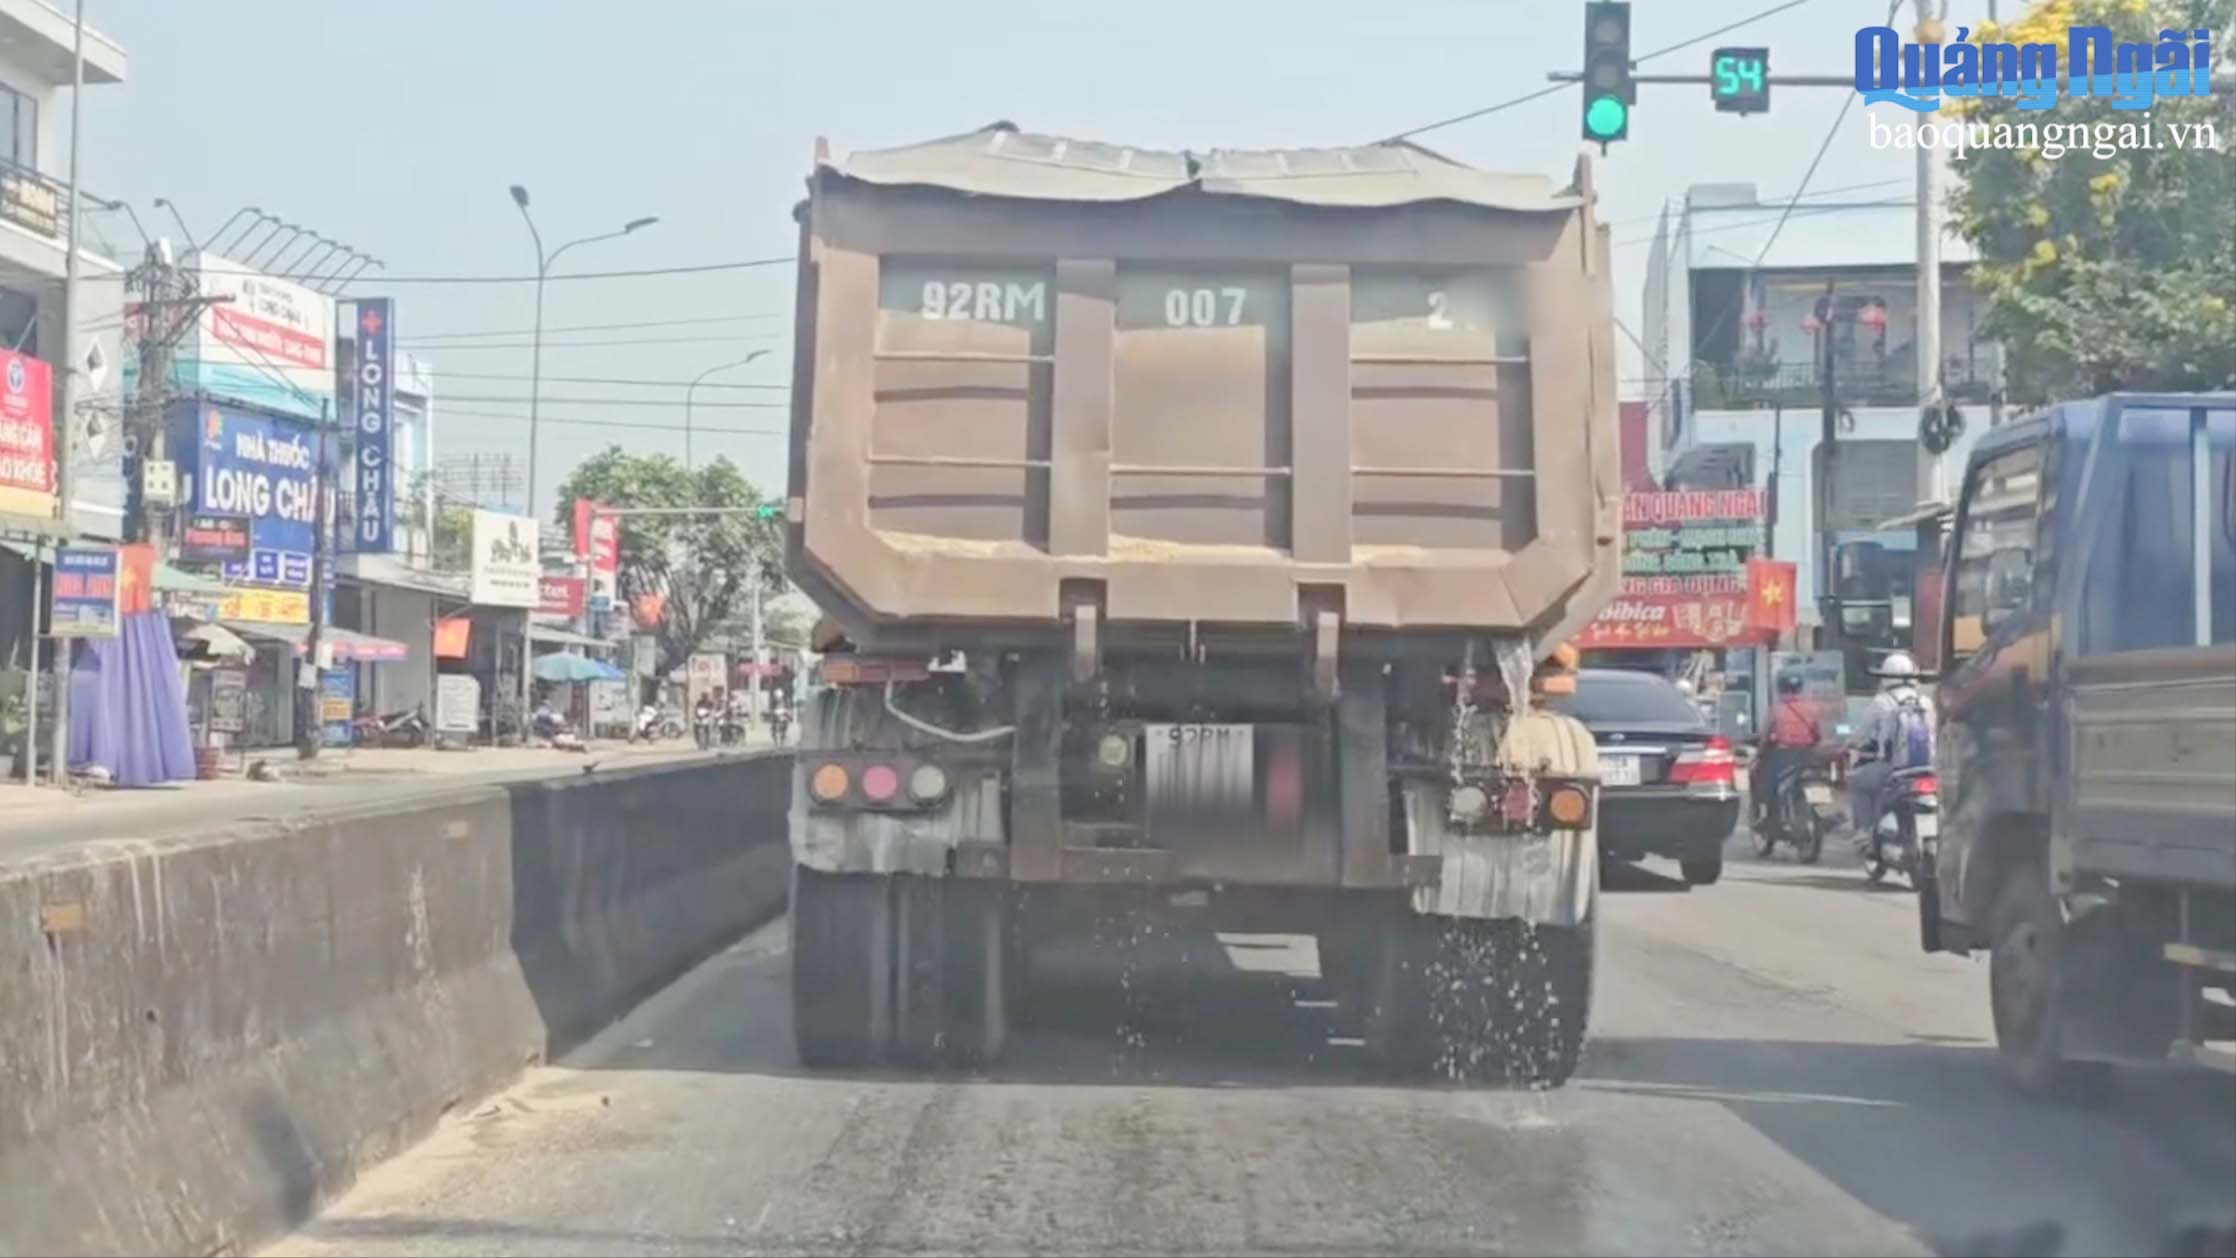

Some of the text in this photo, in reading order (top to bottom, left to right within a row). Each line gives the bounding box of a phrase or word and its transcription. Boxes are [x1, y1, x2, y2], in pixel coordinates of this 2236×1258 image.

[1716, 57, 1761, 94] 54
[921, 281, 1046, 321] 92RM
[1165, 287, 1247, 326] 007
[361, 339, 382, 434] LONG
[236, 431, 266, 462] NHÀ
[206, 465, 271, 517] LONG
